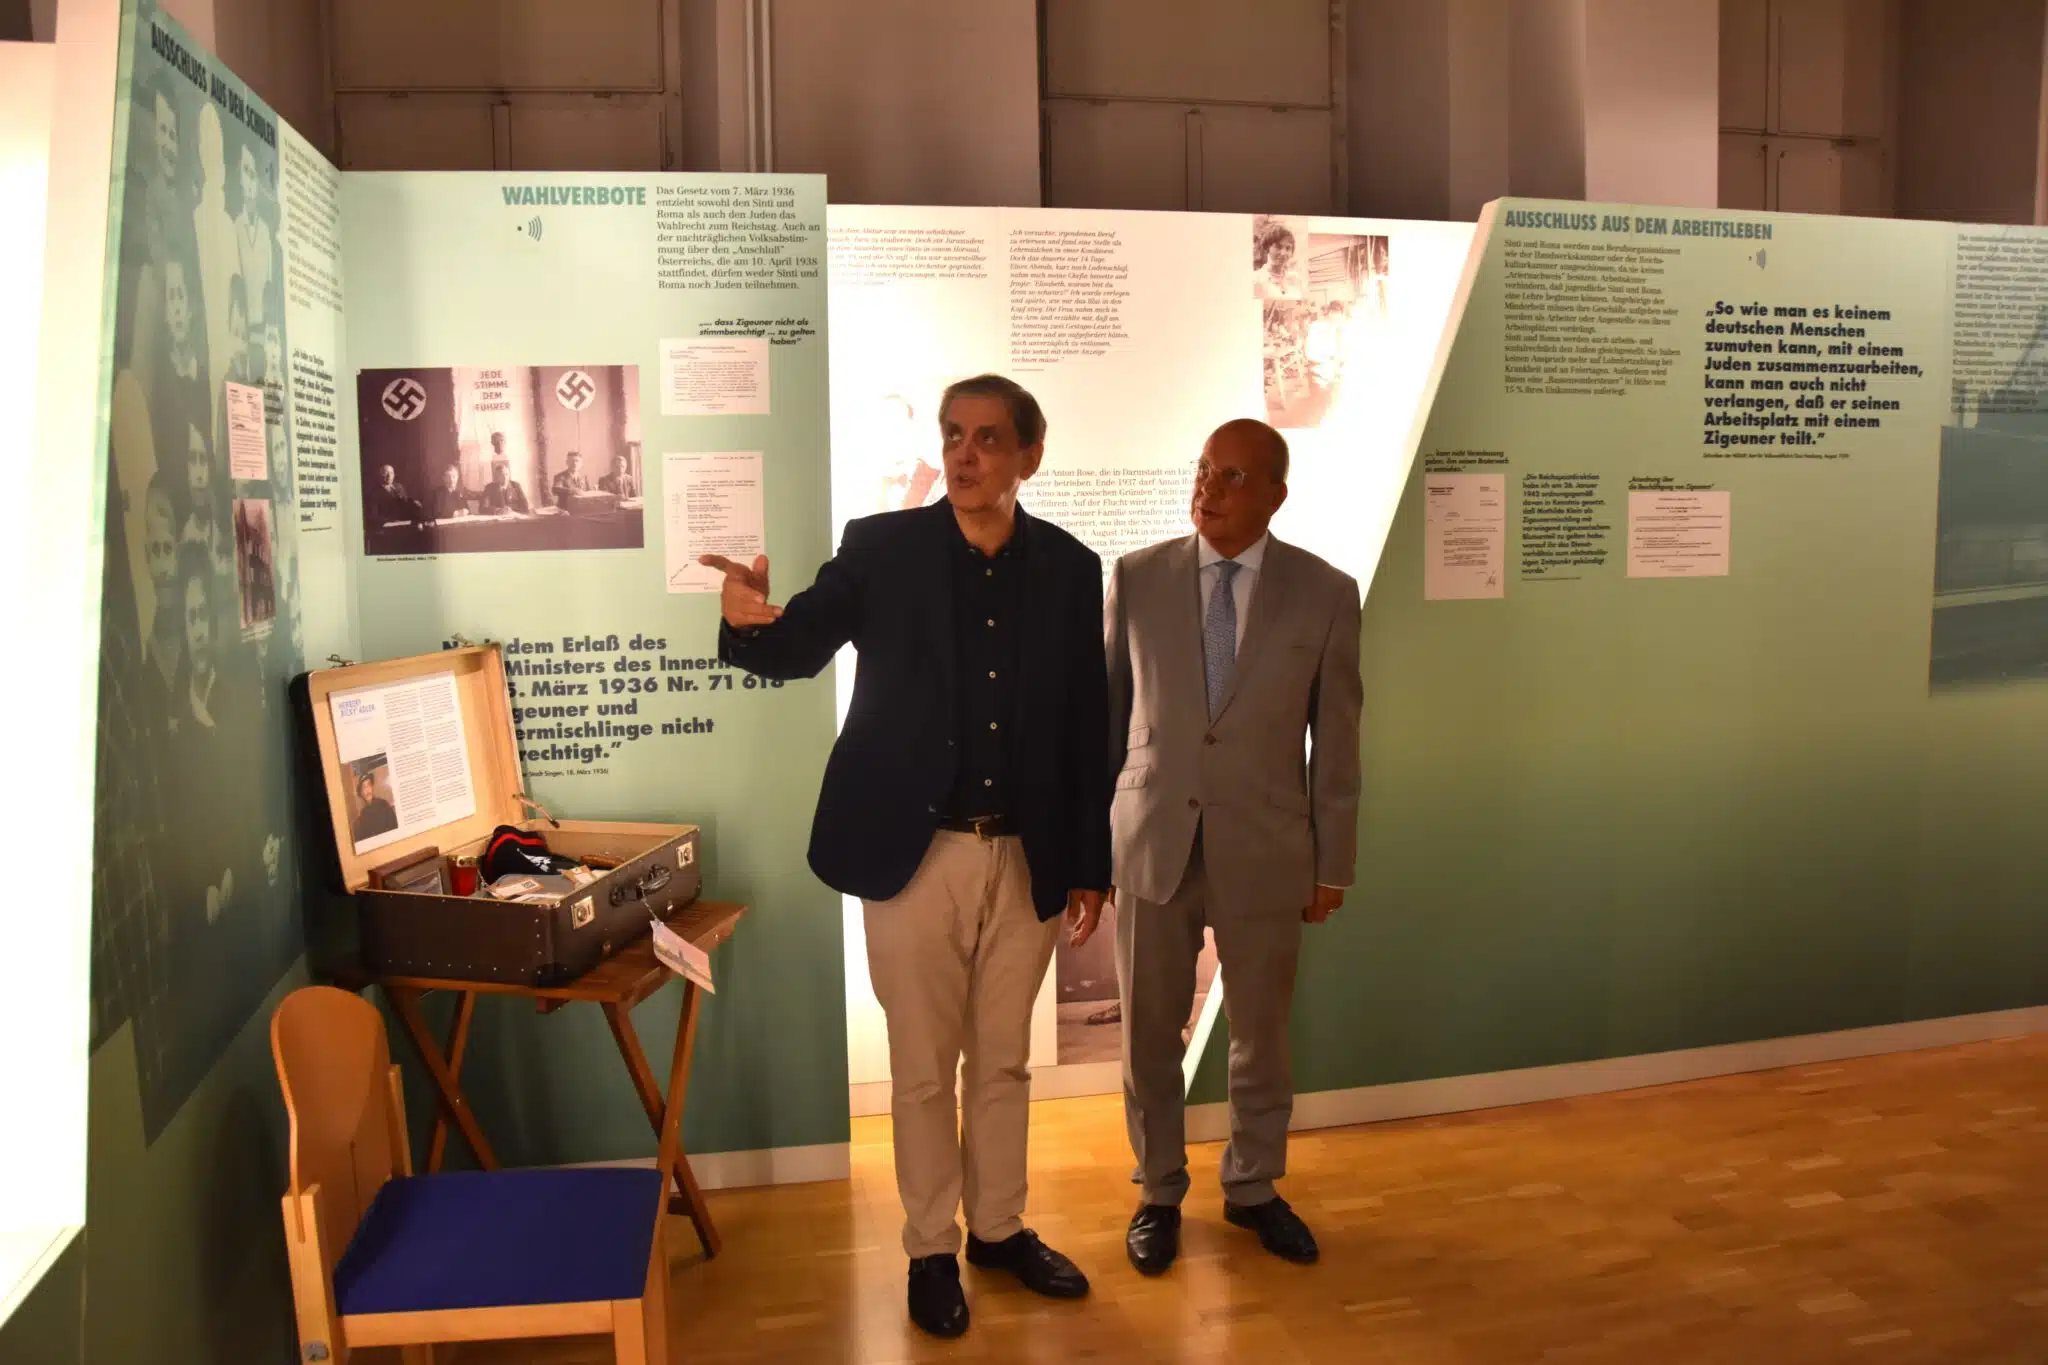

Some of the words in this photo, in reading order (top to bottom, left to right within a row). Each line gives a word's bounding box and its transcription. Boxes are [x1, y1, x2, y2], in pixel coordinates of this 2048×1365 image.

[152, 22, 207, 92] AUSSCHLUSS
[211, 73, 226, 108] AUS
[228, 88, 244, 123] DEN
[246, 104, 275, 149] SCHULEN
[502, 186, 646, 205] WAHLVERBOTE
[656, 186, 674, 195] Das
[677, 187, 707, 195] Gesetz
[733, 187, 741, 195] 7.
[745, 187, 768, 196] März
[772, 187, 794, 196] 1936
[656, 198, 694, 207] entzieht
[698, 198, 730, 207] sowohl
[733, 199, 750, 207] den
[752, 199, 774, 207] Sinti
[776, 199, 794, 207] und
[657, 210, 684, 218] Roma
[687, 210, 700, 219] als
[703, 210, 726, 219] auch
[729, 210, 745, 219] den
[750, 210, 777, 219] Juden
[779, 211, 795, 219] das
[657, 221, 705, 230] Wahlrecht
[731, 222, 778, 233] Reichstag.
[782, 222, 805, 231] Auch
[1505, 210, 1596, 231] AUSSCHLUSS
[1601, 215, 1630, 232] AUS
[1635, 217, 1667, 234] DEM
[1672, 219, 1772, 239] ARBEITSLEBEN
[657, 233, 673, 242] der
[676, 233, 746, 244] nachträglichen
[749, 234, 808, 242] Volksabstim-
[658, 247, 684, 255] mung
[687, 245, 709, 254] über
[712, 245, 729, 254] den
[717, 257, 730, 265] die
[752, 257, 766, 265] 10.
[769, 257, 792, 267] April
[795, 257, 817, 266] 1938
[658, 268, 708, 278] stattfindet,
[711, 269, 743, 277] dürfen
[746, 269, 774, 277] weder
[777, 269, 797, 277] Sinti
[800, 269, 818, 277] und
[659, 280, 685, 289] Roma
[689, 280, 710, 289] noch
[714, 280, 741, 289] Juden
[745, 280, 799, 289] teilnehmen.
[1740, 302, 1768, 316] wie
[1774, 306, 1807, 317] man
[1813, 307, 1829, 319] es
[1835, 305, 1891, 320] keinem
[736, 319, 773, 327] Zigeuner
[1705, 319, 1784, 335] deutschen
[1790, 323, 1865, 338] Menschen
[700, 328, 765, 337] stimmberechtigt
[790, 328, 815, 337] gelten
[1705, 340, 1772, 353] zumuten
[1778, 339, 1822, 357] kann,
[1828, 341, 1853, 355] mit
[1858, 343, 1904, 357] einem
[480, 371, 502, 379] JEDE
[1704, 356, 1752, 372] Juden
[1757, 360, 1923, 378] zusammenzuarbeiten,
[474, 380, 509, 389] STIMME
[1704, 375, 1745, 390] kann
[1751, 378, 1784, 391] man
[1789, 377, 1824, 391] auch
[1830, 377, 1866, 392] nicht
[1704, 394, 1789, 411] verlangen,
[1796, 395, 1825, 409] daß
[1830, 398, 1847, 410] er
[1851, 396, 1900, 410] seinen
[1704, 412, 1799, 430] Arbeitsplatz
[1804, 413, 1829, 428] mit
[1834, 414, 1880, 428] einem
[1703, 431, 1776, 449] Zigeuner
[507, 638, 553, 654] dem
[563, 635, 619, 652] Erlaß
[629, 633, 667, 650] des
[505, 658, 605, 676] Ministers
[613, 656, 651, 672] des
[532, 680, 588, 697] März
[599, 678, 658, 693] 1936
[668, 676, 699, 692] Nr.
[708, 675, 732, 690] 71
[597, 698, 638, 715] und
[662, 717, 714, 734] nicht
